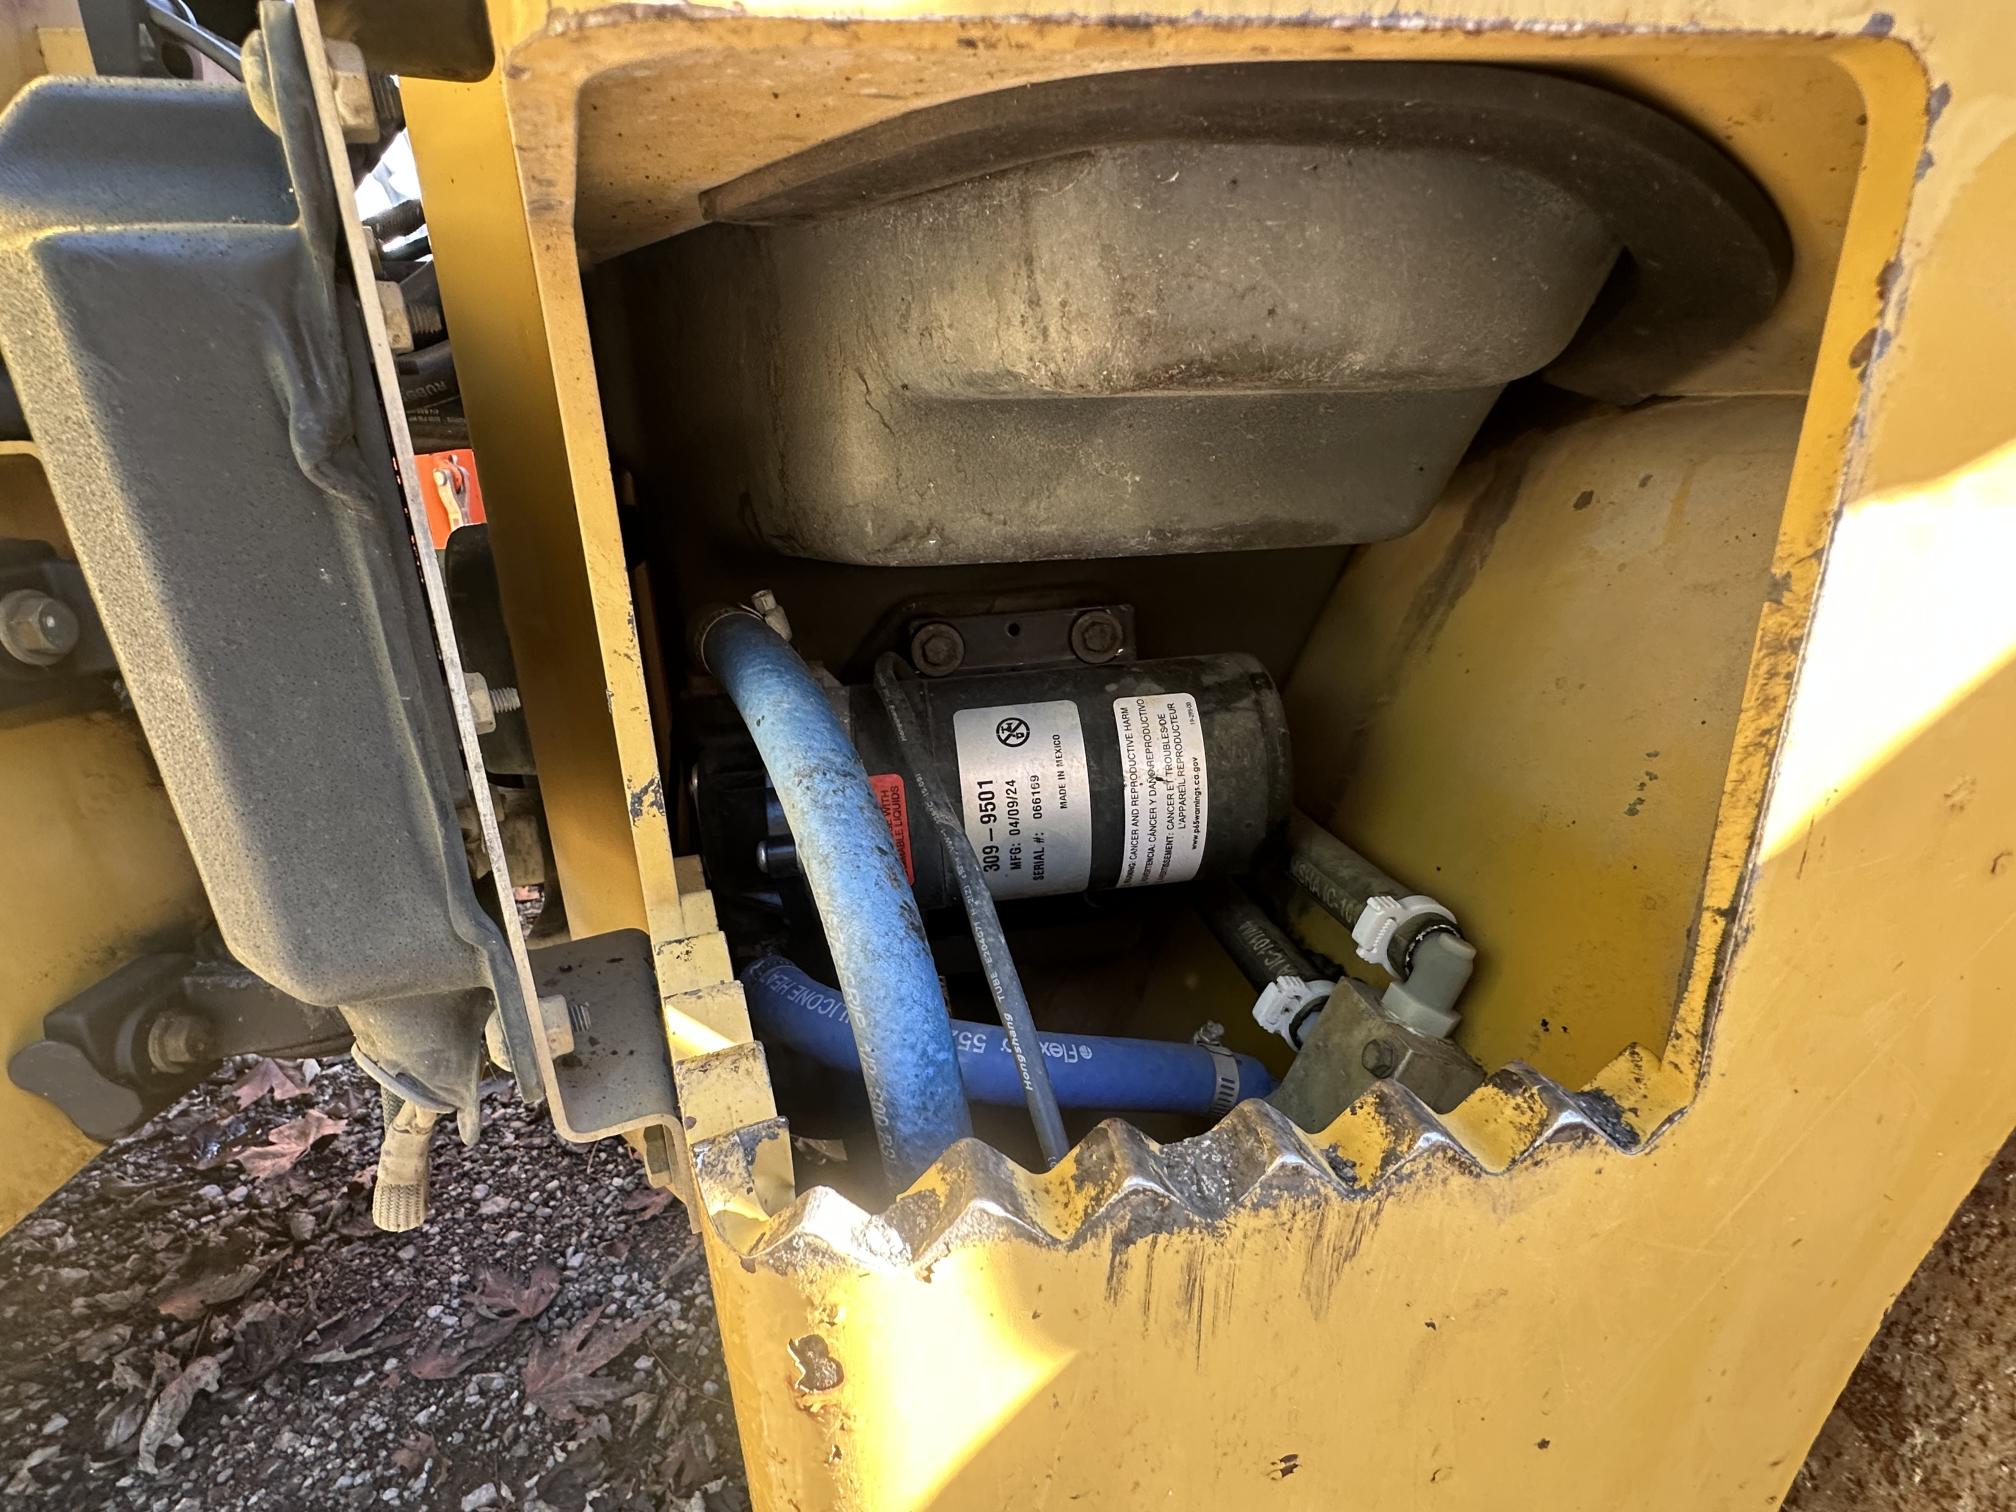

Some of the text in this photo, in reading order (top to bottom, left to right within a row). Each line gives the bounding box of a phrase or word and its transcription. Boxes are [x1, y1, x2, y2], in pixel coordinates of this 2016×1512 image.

[1120, 707, 1132, 732] HARM
[1136, 699, 1154, 768] REPRODUCTIVO
[1157, 714, 1167, 727] DE
[1052, 734, 1068, 810] MADE IN MEXICO
[1124, 733, 1140, 807] REPRODUCTIVE
[1160, 726, 1174, 776] TROUBLES
[1167, 702, 1187, 830] L'APPAREIL REPRODUCTEUR
[880, 789, 891, 817] WITH
[890, 785, 903, 826] LIQUIDS
[1029, 774, 1043, 820] 066169
[1131, 808, 1140, 828] AND
[1166, 792, 1175, 831] CANCER
[1191, 757, 1202, 850] www.p65warnings.ca.gov
[1004, 778, 1022, 871] MFG: 04/09/24
[1129, 829, 1139, 860] CANCER
[1032, 847, 1045, 881] SERIAL
[990, 971, 1005, 1003] TUBE
[1004, 1012, 1033, 1091] Hongshang
